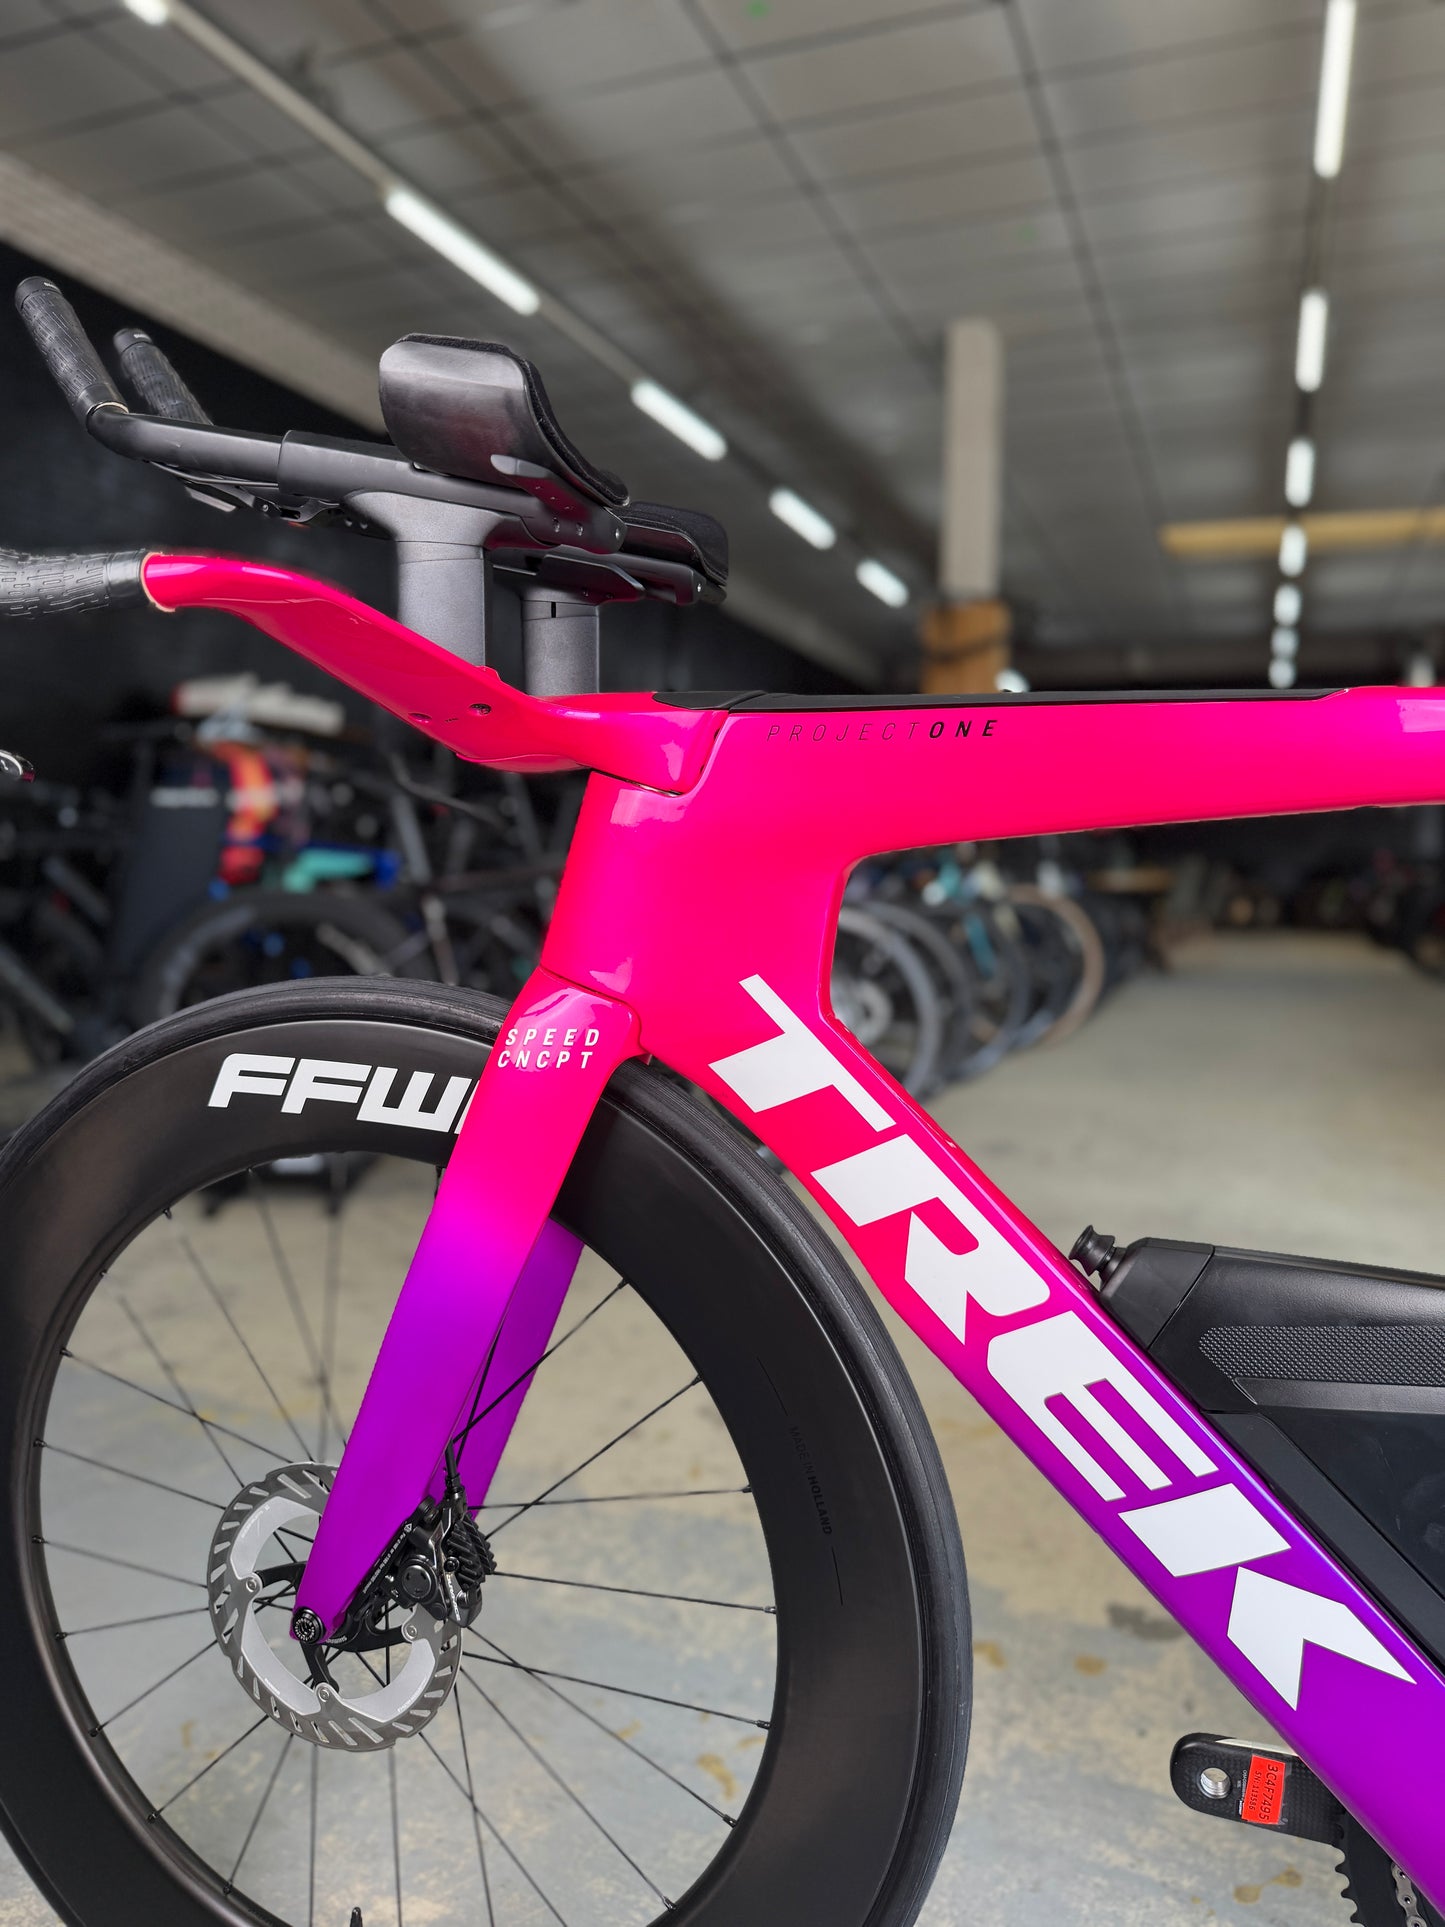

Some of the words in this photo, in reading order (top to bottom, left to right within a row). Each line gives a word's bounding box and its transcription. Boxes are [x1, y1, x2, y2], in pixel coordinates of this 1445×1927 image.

[497, 1050, 593, 1069] CNCPT
[505, 1028, 600, 1046] SPEED
[207, 1053, 481, 1134] FFW
[708, 974, 1417, 1712] TREK
[789, 1425, 810, 1460] MADE
[802, 1462, 816, 1474] IN
[807, 1475, 833, 1535] HOLLAND
[1258, 1763, 1279, 1821] 3C4F7495
